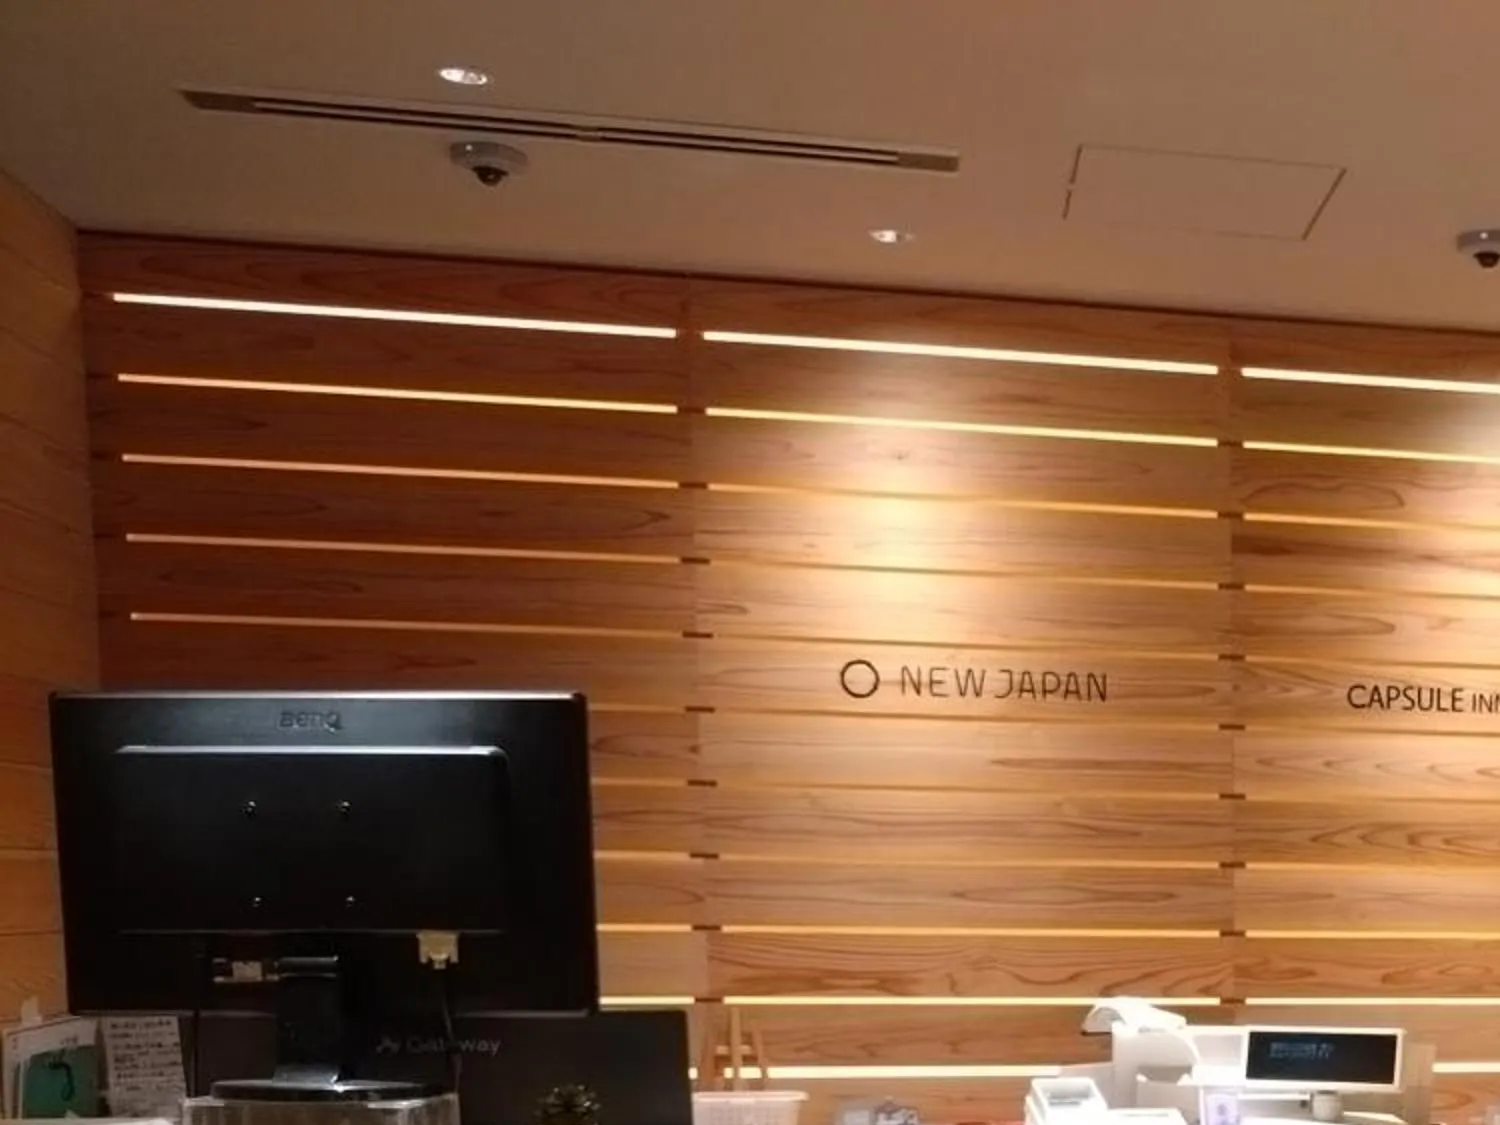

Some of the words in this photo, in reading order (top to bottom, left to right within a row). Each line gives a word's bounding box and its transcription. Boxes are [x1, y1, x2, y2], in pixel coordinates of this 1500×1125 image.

[900, 665, 986, 698] NEW
[995, 669, 1107, 702] JAPAN
[1347, 683, 1465, 713] CAPSULE
